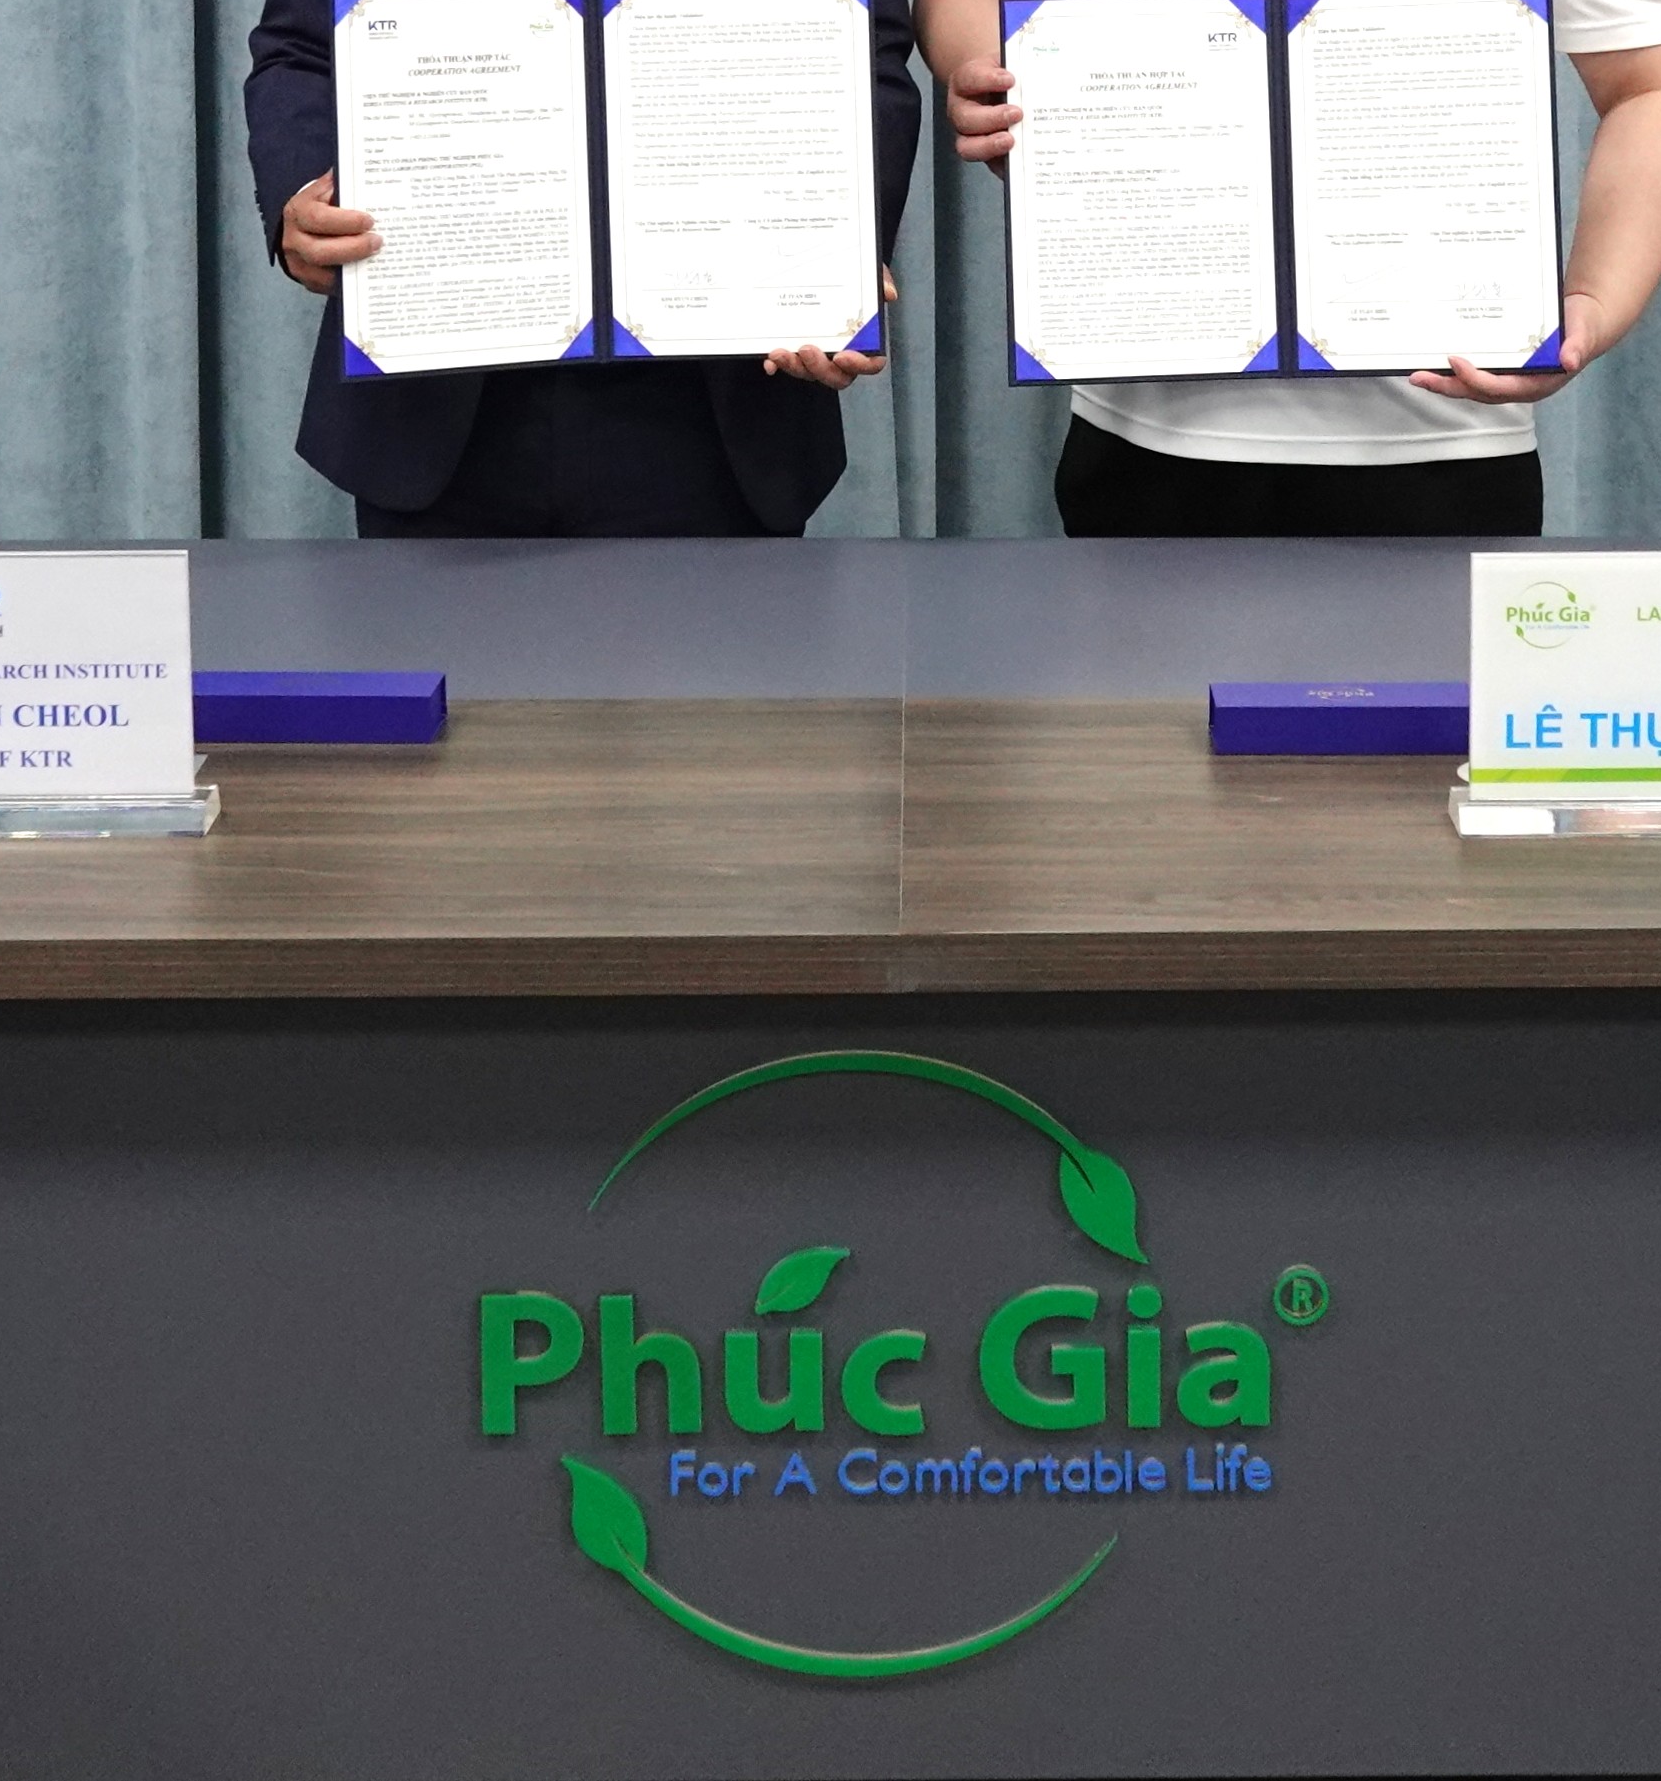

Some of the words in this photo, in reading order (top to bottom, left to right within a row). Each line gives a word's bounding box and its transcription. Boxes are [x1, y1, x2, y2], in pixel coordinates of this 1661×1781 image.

[368, 20, 398, 31] KTR
[1208, 32, 1237, 43] KTR
[1559, 606, 1590, 622] Gia
[54, 663, 169, 680] INSTITUTE
[13, 704, 130, 728] CHEOL
[1505, 705, 1563, 749] LÊ
[20, 749, 73, 768] KTR
[479, 1247, 927, 1437] Phúc
[978, 1283, 1273, 1431] Gia
[669, 1448, 756, 1497] For
[775, 1450, 819, 1496] A
[837, 1447, 1168, 1496] Comfortable
[1185, 1442, 1273, 1492] Life
